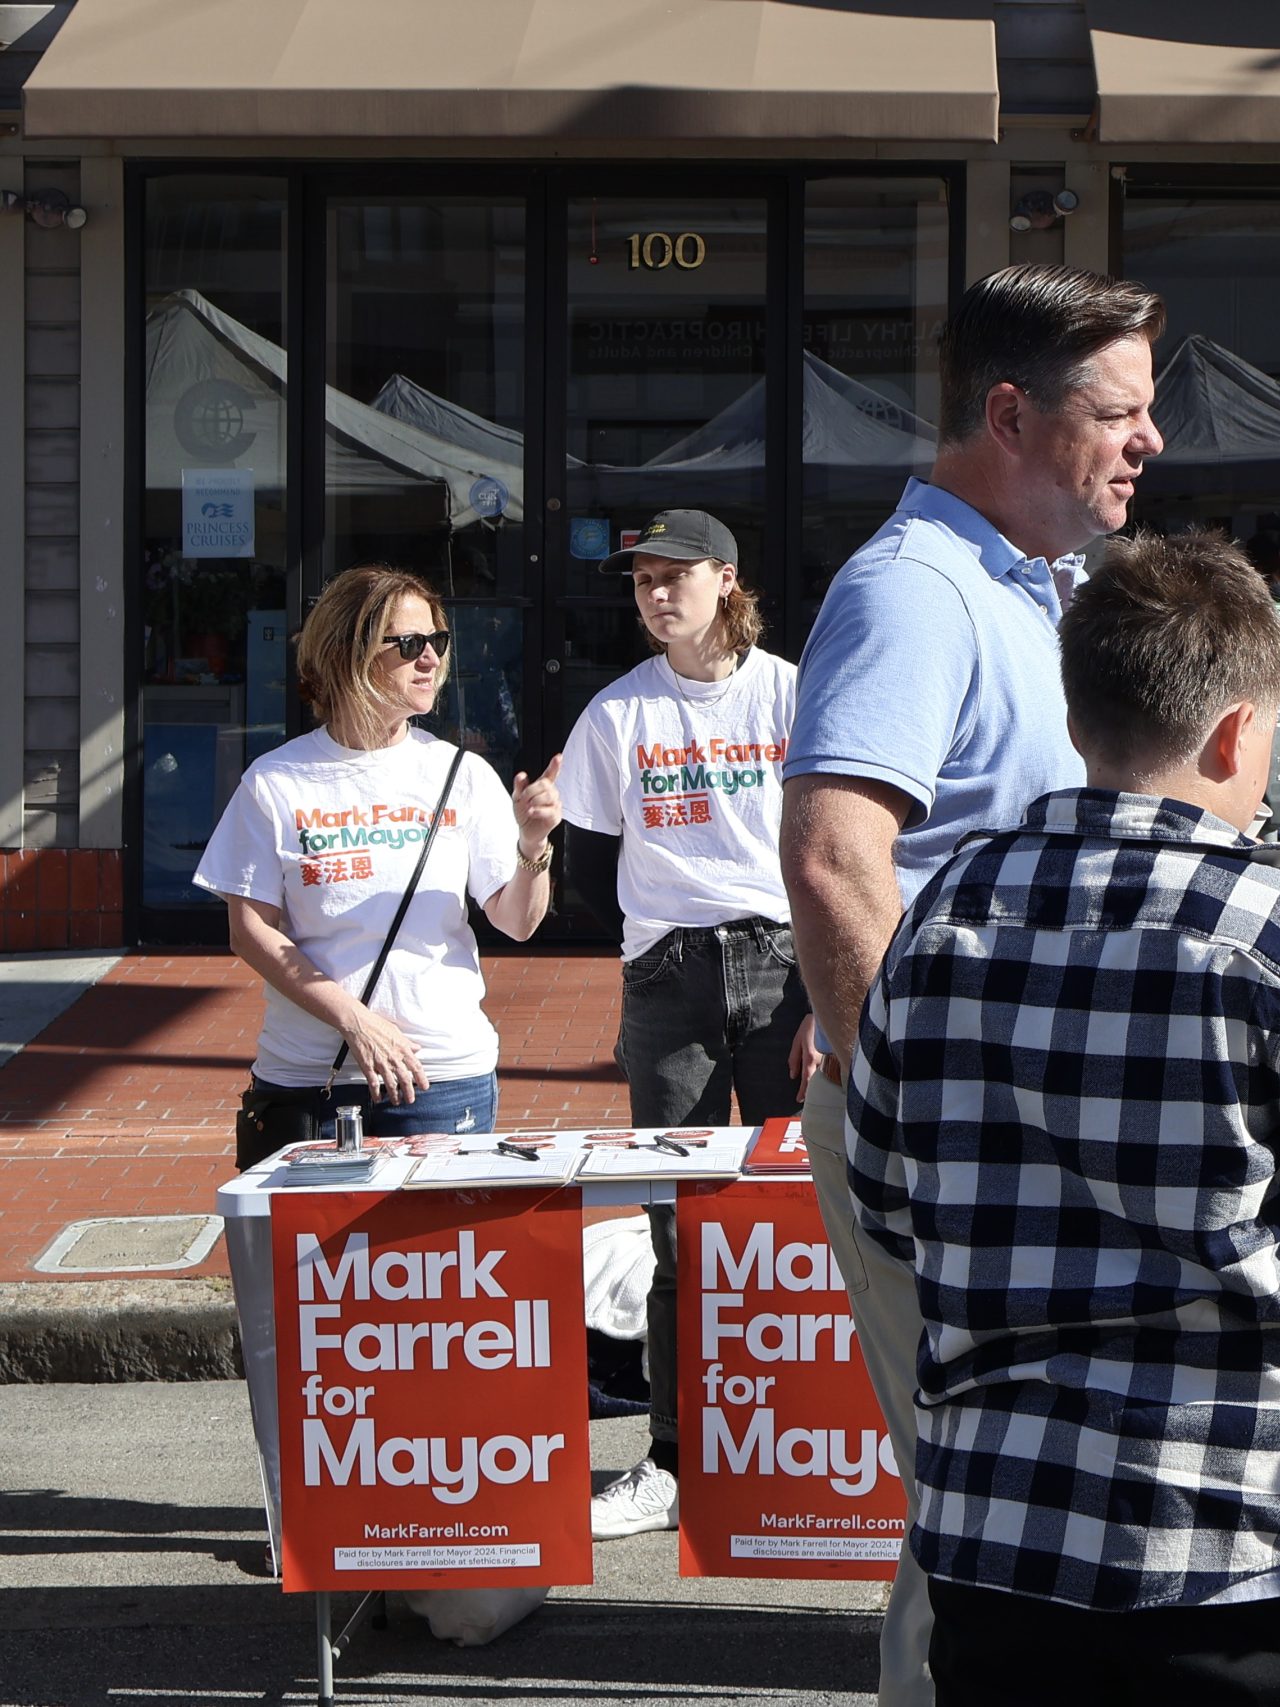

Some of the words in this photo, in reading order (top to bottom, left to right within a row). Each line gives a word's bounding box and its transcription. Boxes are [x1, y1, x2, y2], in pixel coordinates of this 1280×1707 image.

[625, 232, 706, 269] 100
[187, 522, 249, 535] PRINCESS
[190, 535, 247, 547] CRUISES
[637, 739, 706, 769] Mark
[641, 769, 679, 794] for
[681, 765, 766, 795] Mayor
[295, 805, 369, 830] Mark
[642, 800, 712, 829] 麥法恩
[299, 829, 340, 854] for
[296, 1230, 509, 1302] Mark
[701, 1221, 846, 1292] Ma
[299, 1299, 551, 1372] Farrell
[701, 1293, 856, 1362] Farr
[301, 1374, 375, 1416] for
[702, 1363, 776, 1405] for
[302, 1417, 565, 1505] Mayor
[702, 1406, 902, 1498] May
[364, 1522, 509, 1539] MarkFarrell.com
[760, 1513, 906, 1530] MarkFarrell.com
[338, 1550, 356, 1558] Paid
[358, 1550, 371, 1558] for
[372, 1550, 383, 1559] by
[384, 1549, 404, 1558] Mark
[406, 1549, 432, 1558] Farrell
[433, 1549, 444, 1557] for
[446, 1549, 472, 1559] Mayor
[473, 1548, 498, 1556] 2024.
[499, 1546, 536, 1556] Financial
[734, 1537, 753, 1546] Paid
[754, 1538, 766, 1546] for
[768, 1539, 779, 1548] by
[780, 1539, 800, 1547] Mark
[802, 1540, 827, 1548] Farrell
[829, 1540, 840, 1548] for
[842, 1540, 868, 1549] Mayor
[870, 1541, 893, 1549] 2024.
[753, 1548, 799, 1556] disclosures
[816, 1549, 852, 1557] available
[864, 1550, 902, 1558] sfethics.
[357, 1559, 403, 1567] disclosures
[420, 1558, 457, 1566] available
[458, 1558, 467, 1566] at
[468, 1557, 518, 1567] sfethics.org.
